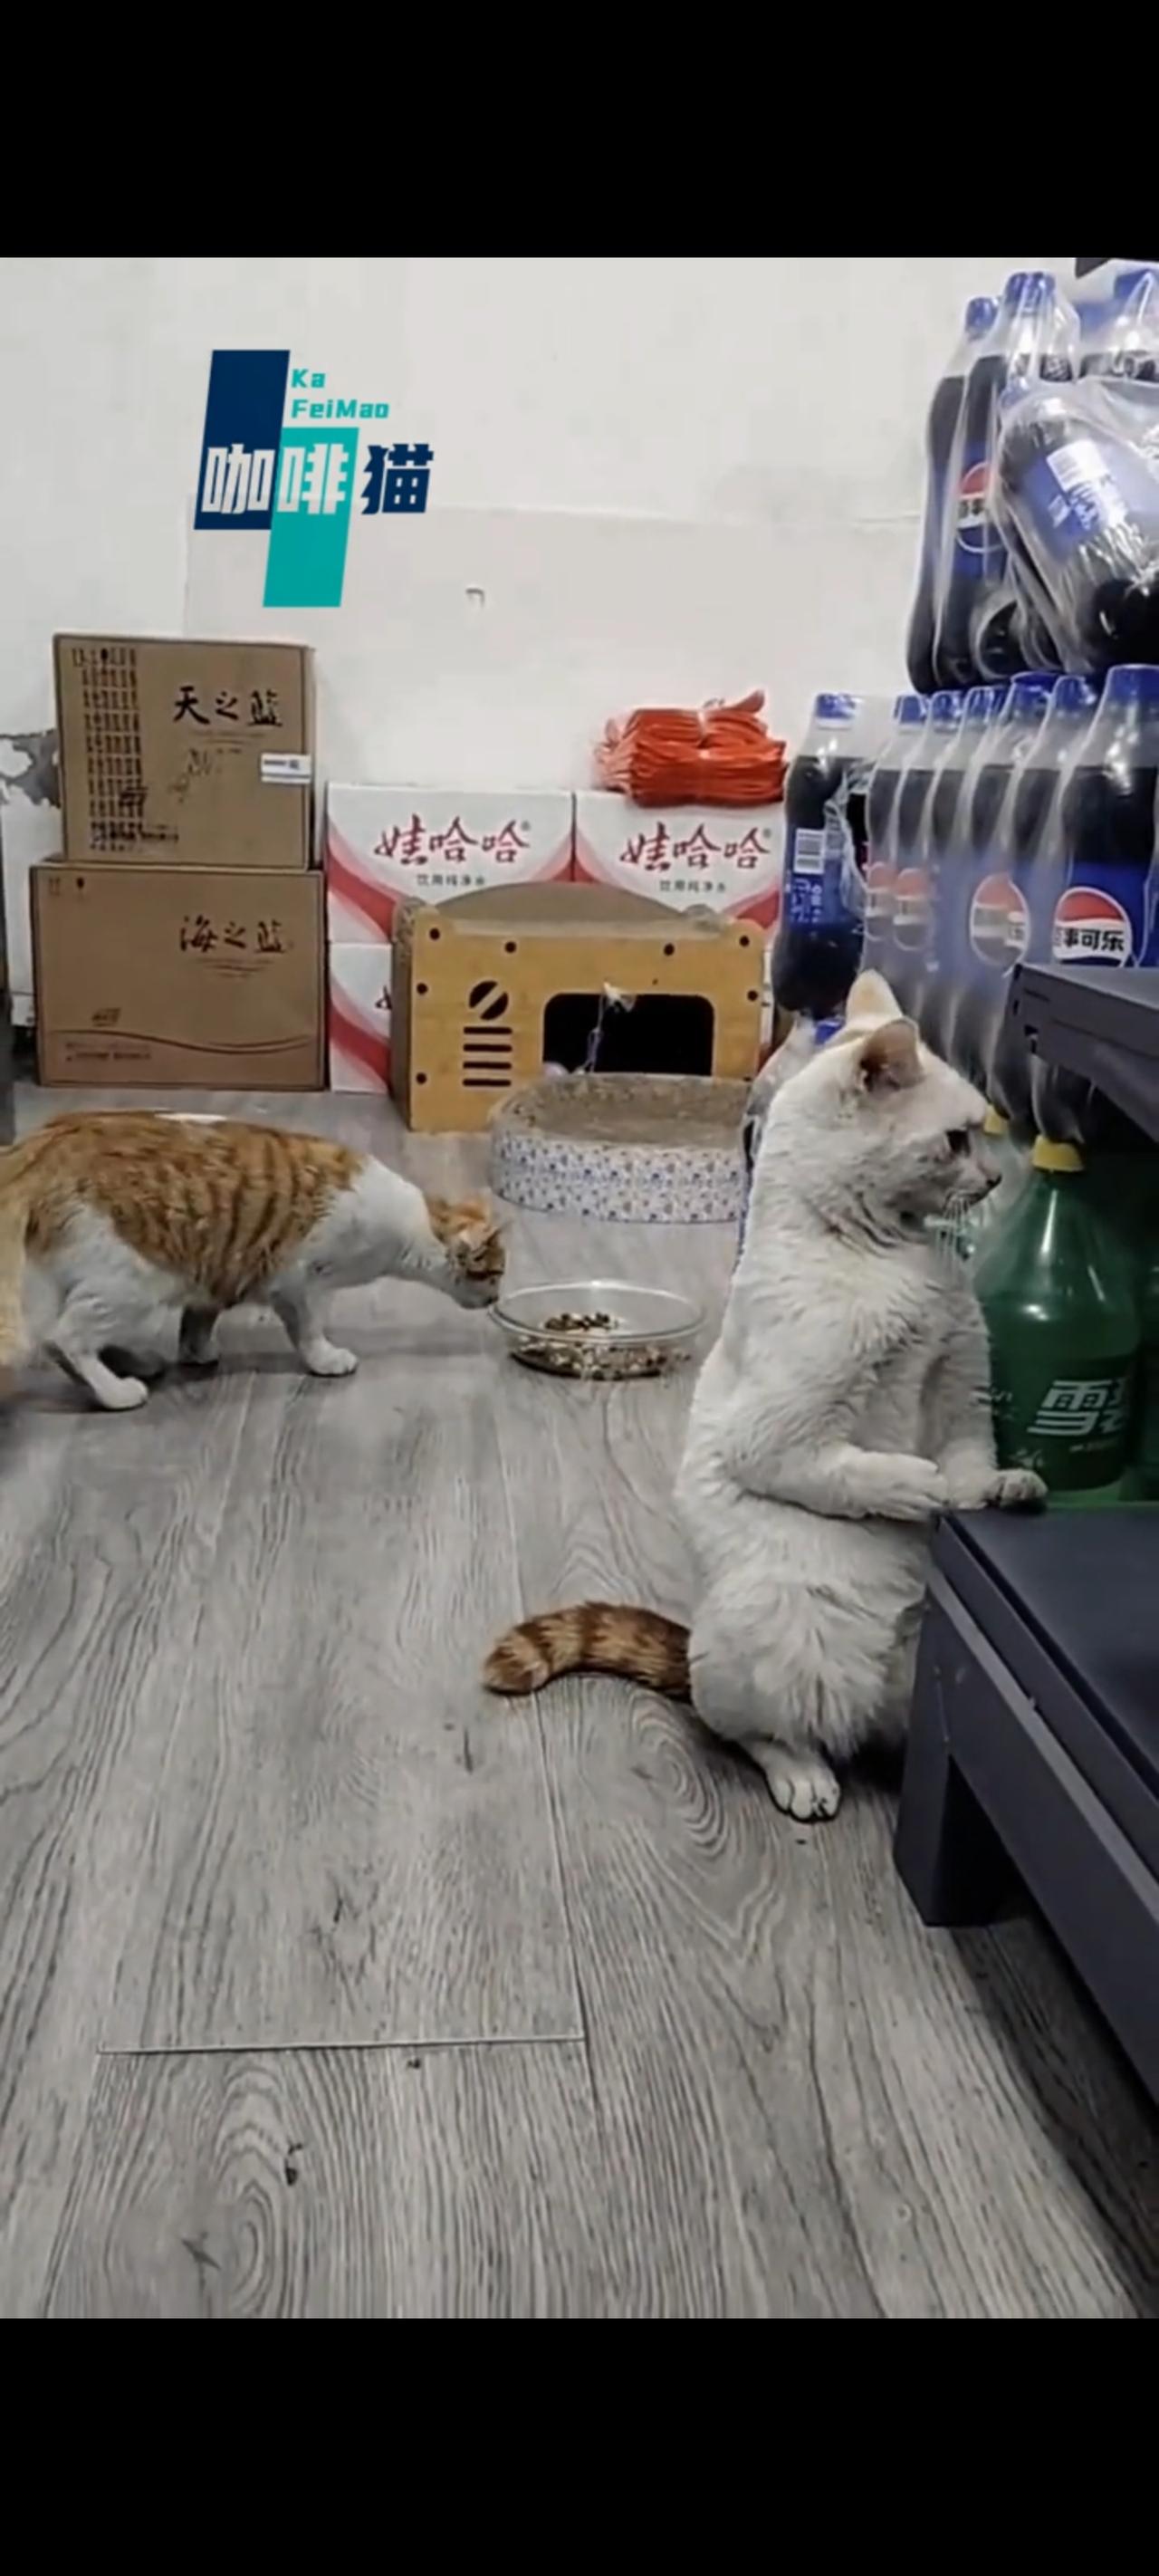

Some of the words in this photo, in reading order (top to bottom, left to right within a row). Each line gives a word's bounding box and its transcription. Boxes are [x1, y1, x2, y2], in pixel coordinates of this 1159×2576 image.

[373, 813, 530, 869] 娃哈哈
[619, 821, 771, 871] 娃哈哈
